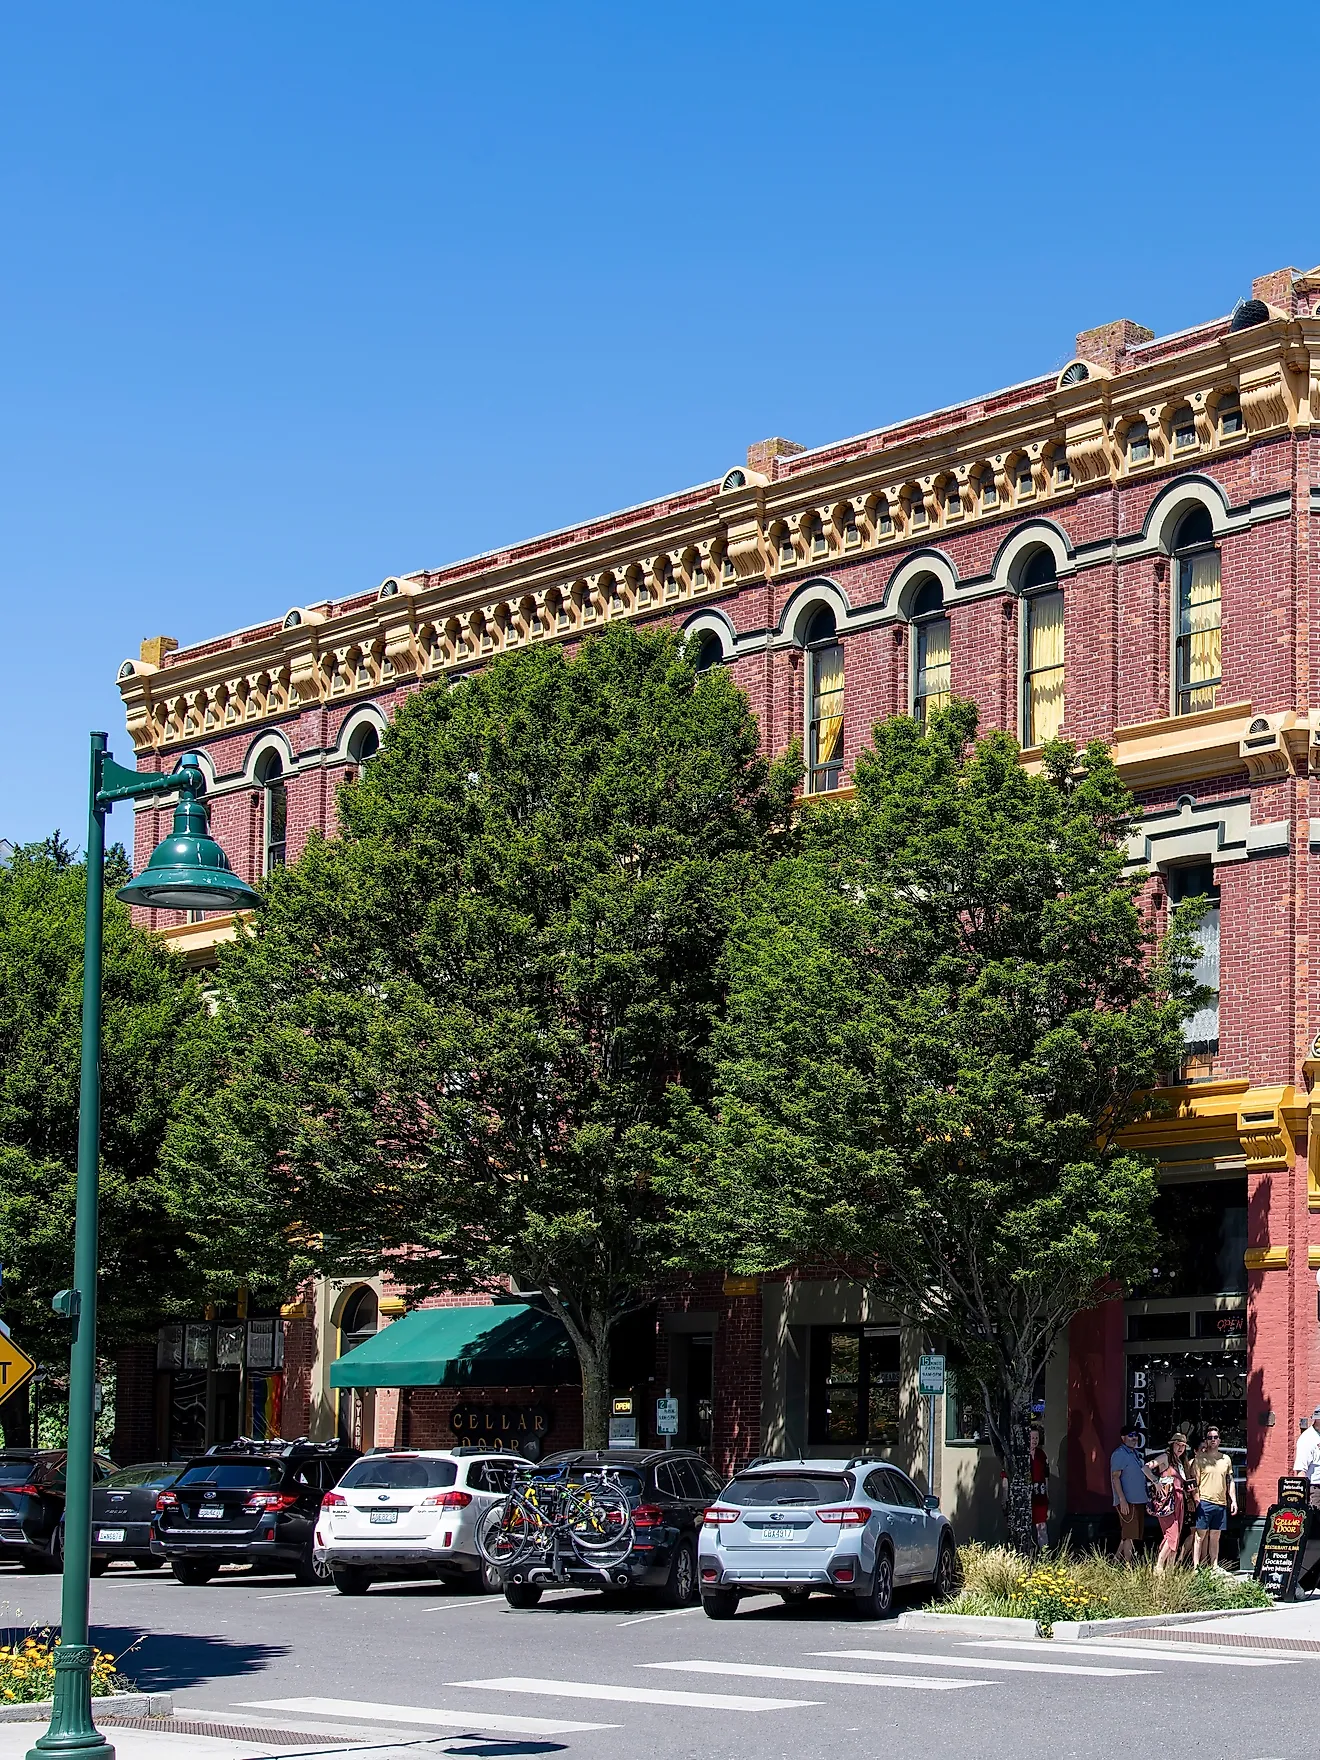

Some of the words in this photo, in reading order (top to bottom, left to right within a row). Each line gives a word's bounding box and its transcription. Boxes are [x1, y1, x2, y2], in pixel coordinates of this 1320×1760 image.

[1217, 1319, 1243, 1329] OPEN
[922, 1357, 930, 1366] 15
[615, 1402, 631, 1411] OPEN
[453, 1413, 544, 1430] CELLAR
[461, 1436, 519, 1451] DOOR
[1274, 1518, 1301, 1526] CELLAR
[1276, 1525, 1297, 1533] DOOR
